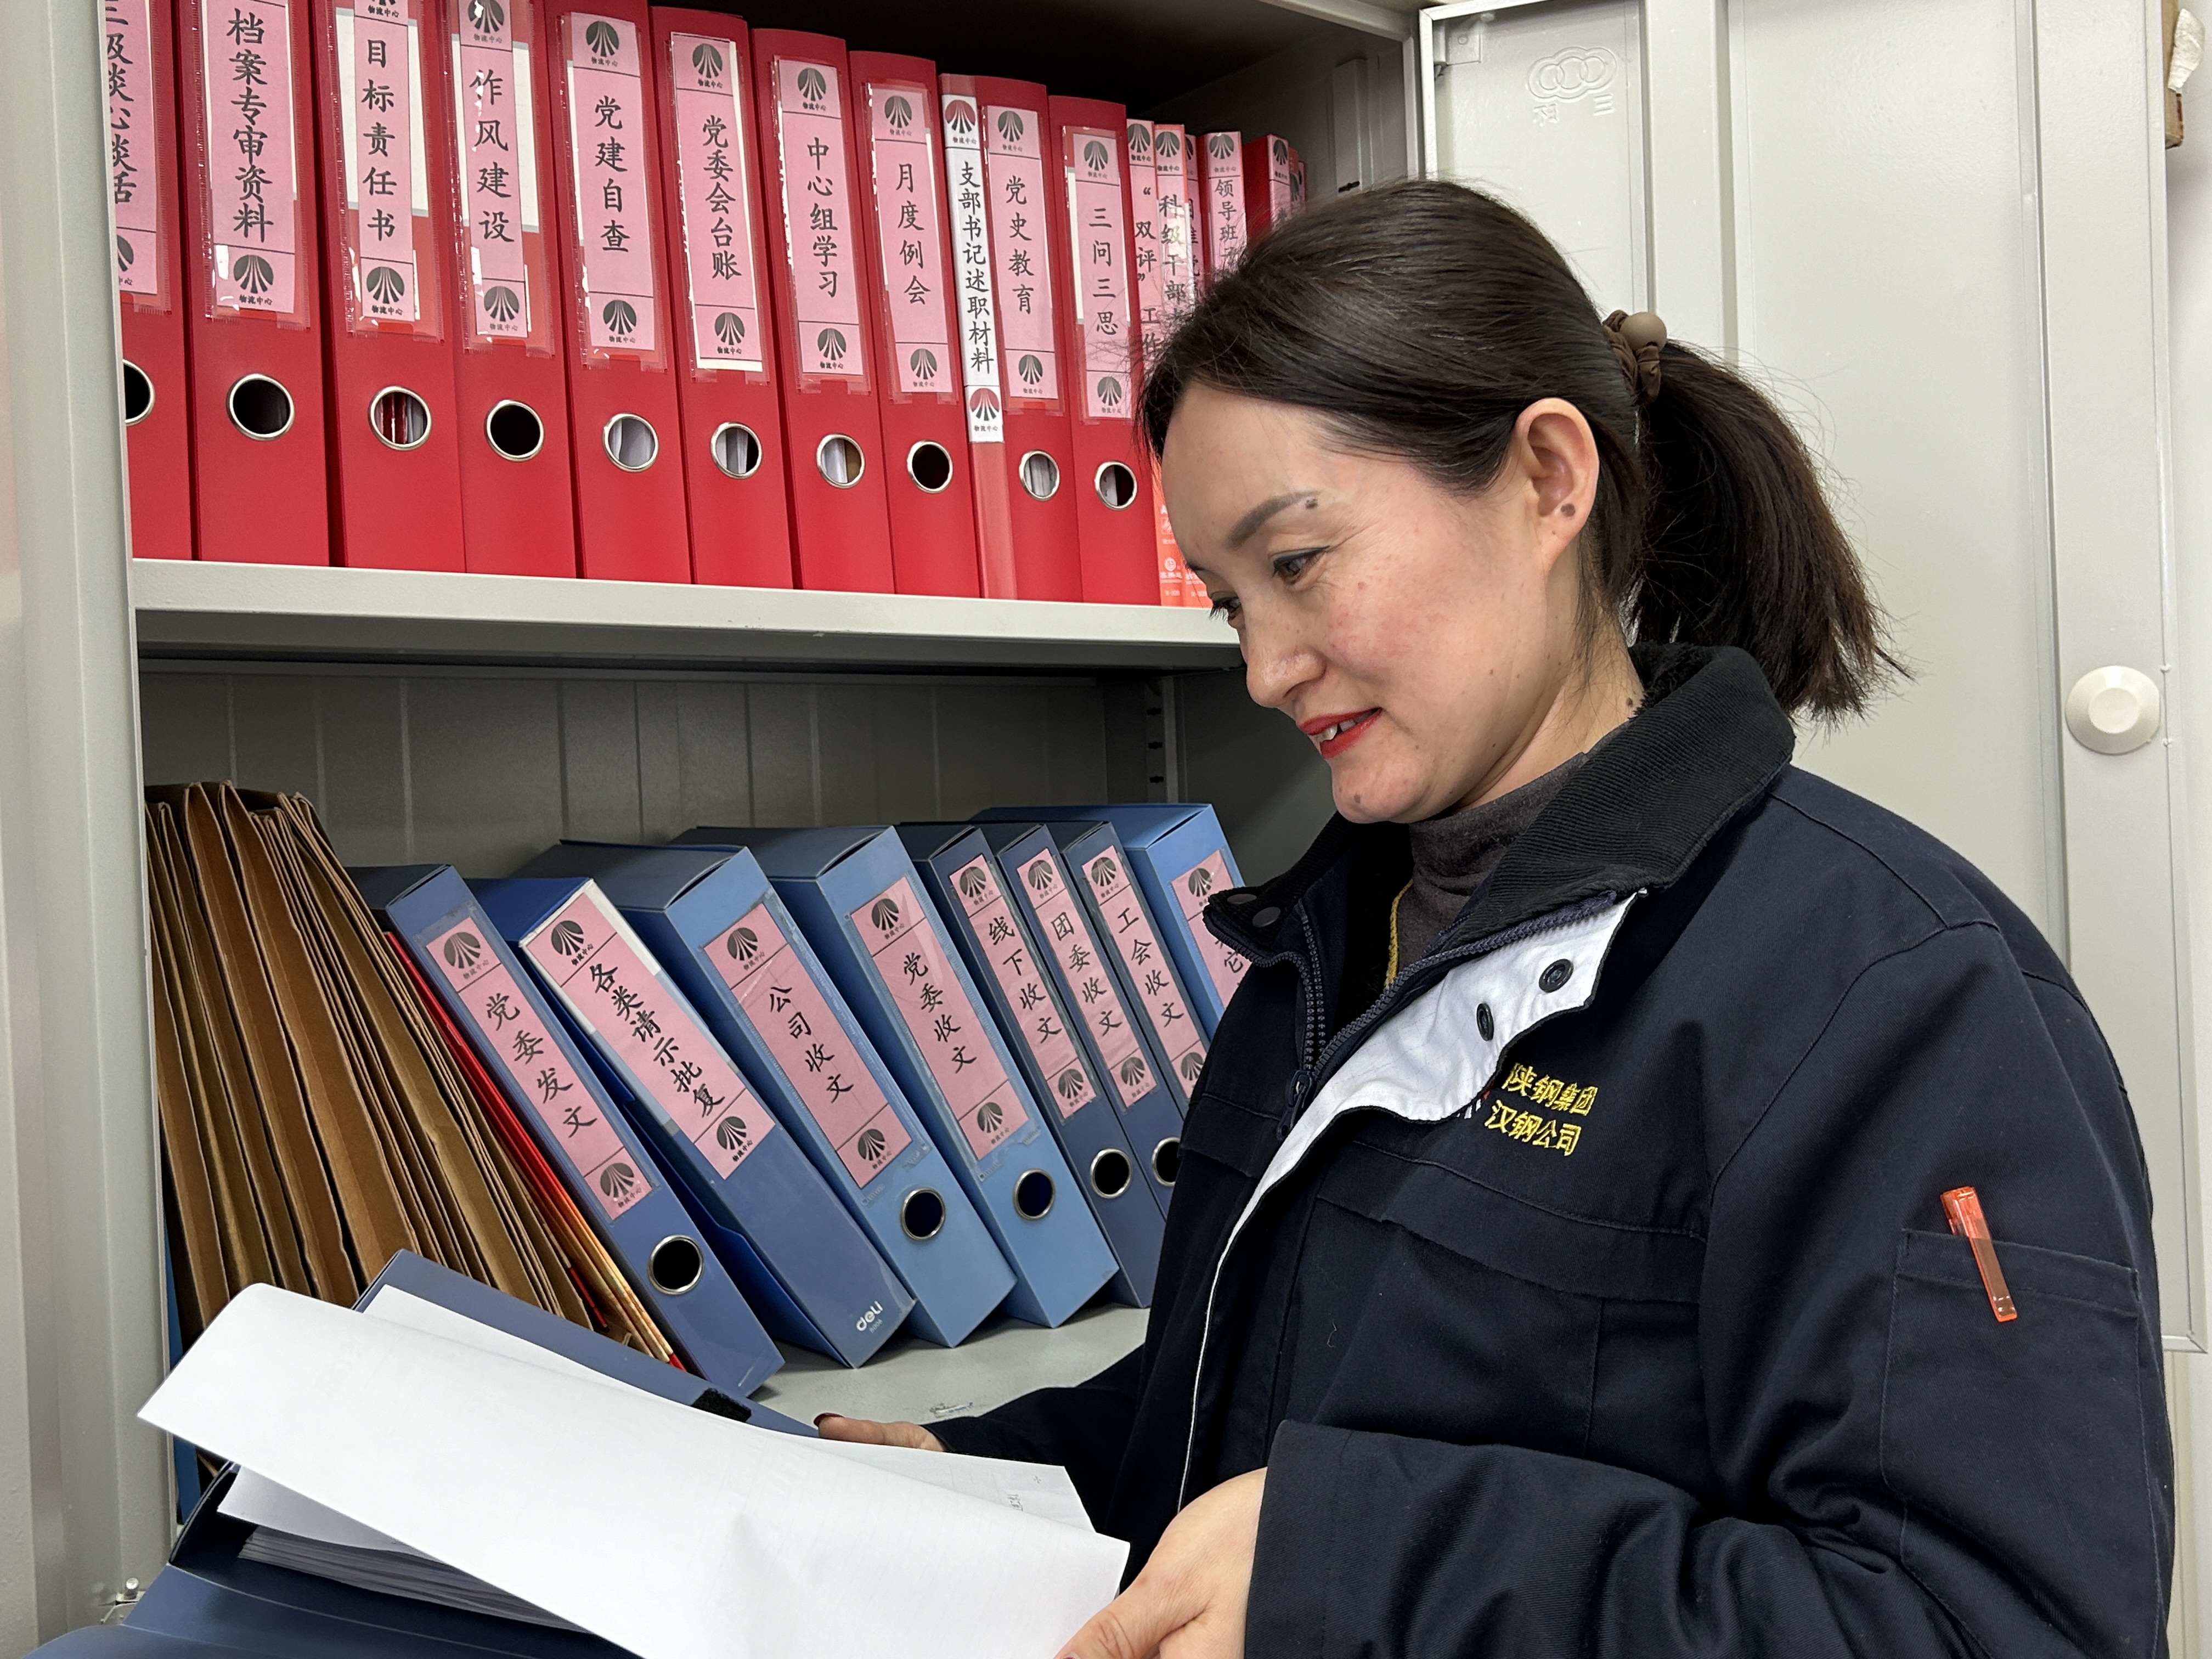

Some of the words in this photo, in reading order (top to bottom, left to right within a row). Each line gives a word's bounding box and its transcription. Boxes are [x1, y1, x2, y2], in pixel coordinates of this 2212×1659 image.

[368, 5, 399, 18] 物流中心
[473, 33, 503, 44] 物流中心
[591, 57, 618, 67] 物流中心
[697, 78, 723, 88] 物流中心
[803, 101, 826, 111] 物流中心
[226, 8, 274, 242] 档案专审资料
[362, 40, 397, 241] 目标责任书
[952, 136, 977, 144] 物流中心
[1002, 143, 1023, 151] 物流中心
[470, 70, 515, 242] 作风建设
[594, 95, 630, 252] 党建自查
[702, 115, 742, 280] 党委会台账
[807, 137, 838, 297] 中心组学习
[895, 163, 930, 304] 月度例会
[1006, 175, 1035, 314] 党史教育
[958, 161, 994, 374] 支部书记述职材料
[1089, 207, 1118, 336] 三问三思
[239, 295, 273, 306] 物流中心
[371, 305, 403, 315] 物流中心
[489, 323, 518, 331] 物流中心
[609, 335, 636, 344] 物流中心
[716, 346, 742, 355] 物流中心
[820, 361, 844, 369] 物流中心
[973, 890, 994, 906] 物流中心
[884, 923, 905, 940] 物流中心
[571, 944, 594, 966] 物流中心
[743, 951, 765, 971] 物流中心
[464, 960, 489, 979] 物流中心
[1051, 912, 1122, 1036] 团委收文
[1118, 907, 1184, 1028] 工会收文
[989, 916, 1062, 1043] 线下收文
[903, 952, 977, 1073] 党委收文
[589, 963, 725, 1118] 各类请示批复
[770, 986, 854, 1103] 公司收文
[487, 992, 597, 1138] 党委发文
[1502, 1062, 1598, 1116] 陕钢集团
[991, 1127, 1009, 1144] 物流中心
[1484, 1100, 1582, 1156] 汉钢公司
[732, 1139, 753, 1162] 物流中心
[872, 1150, 892, 1169] 物流中心
[618, 1187, 642, 1208] 物流中心
[856, 1300, 883, 1331] deli
